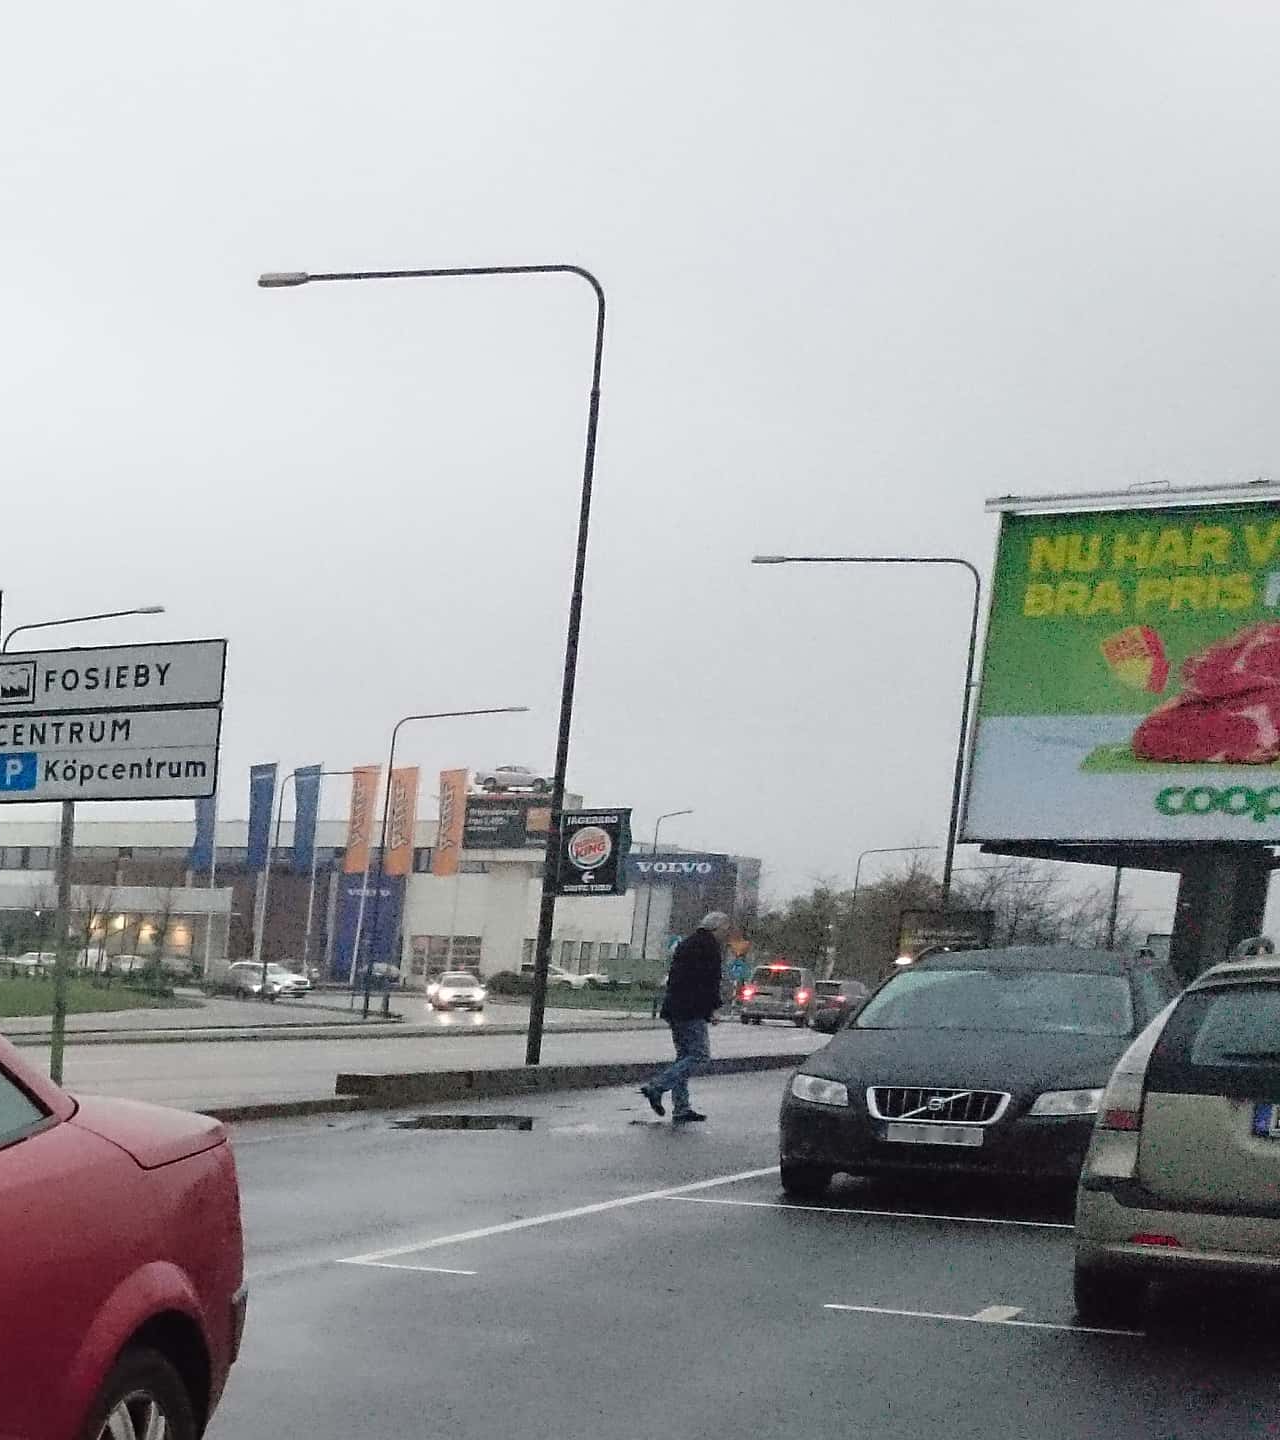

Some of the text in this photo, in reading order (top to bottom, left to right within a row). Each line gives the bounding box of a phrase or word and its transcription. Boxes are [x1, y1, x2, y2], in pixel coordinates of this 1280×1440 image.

[1028, 535, 1102, 572] NU
[1112, 526, 1232, 570] HAR
[1023, 579, 1123, 617] BRA
[44, 662, 172, 693] FOSIEBY
[5, 757, 207, 787] P Köpcentrum
[575, 841, 606, 857] KING
[636, 862, 711, 873] VOLVO
